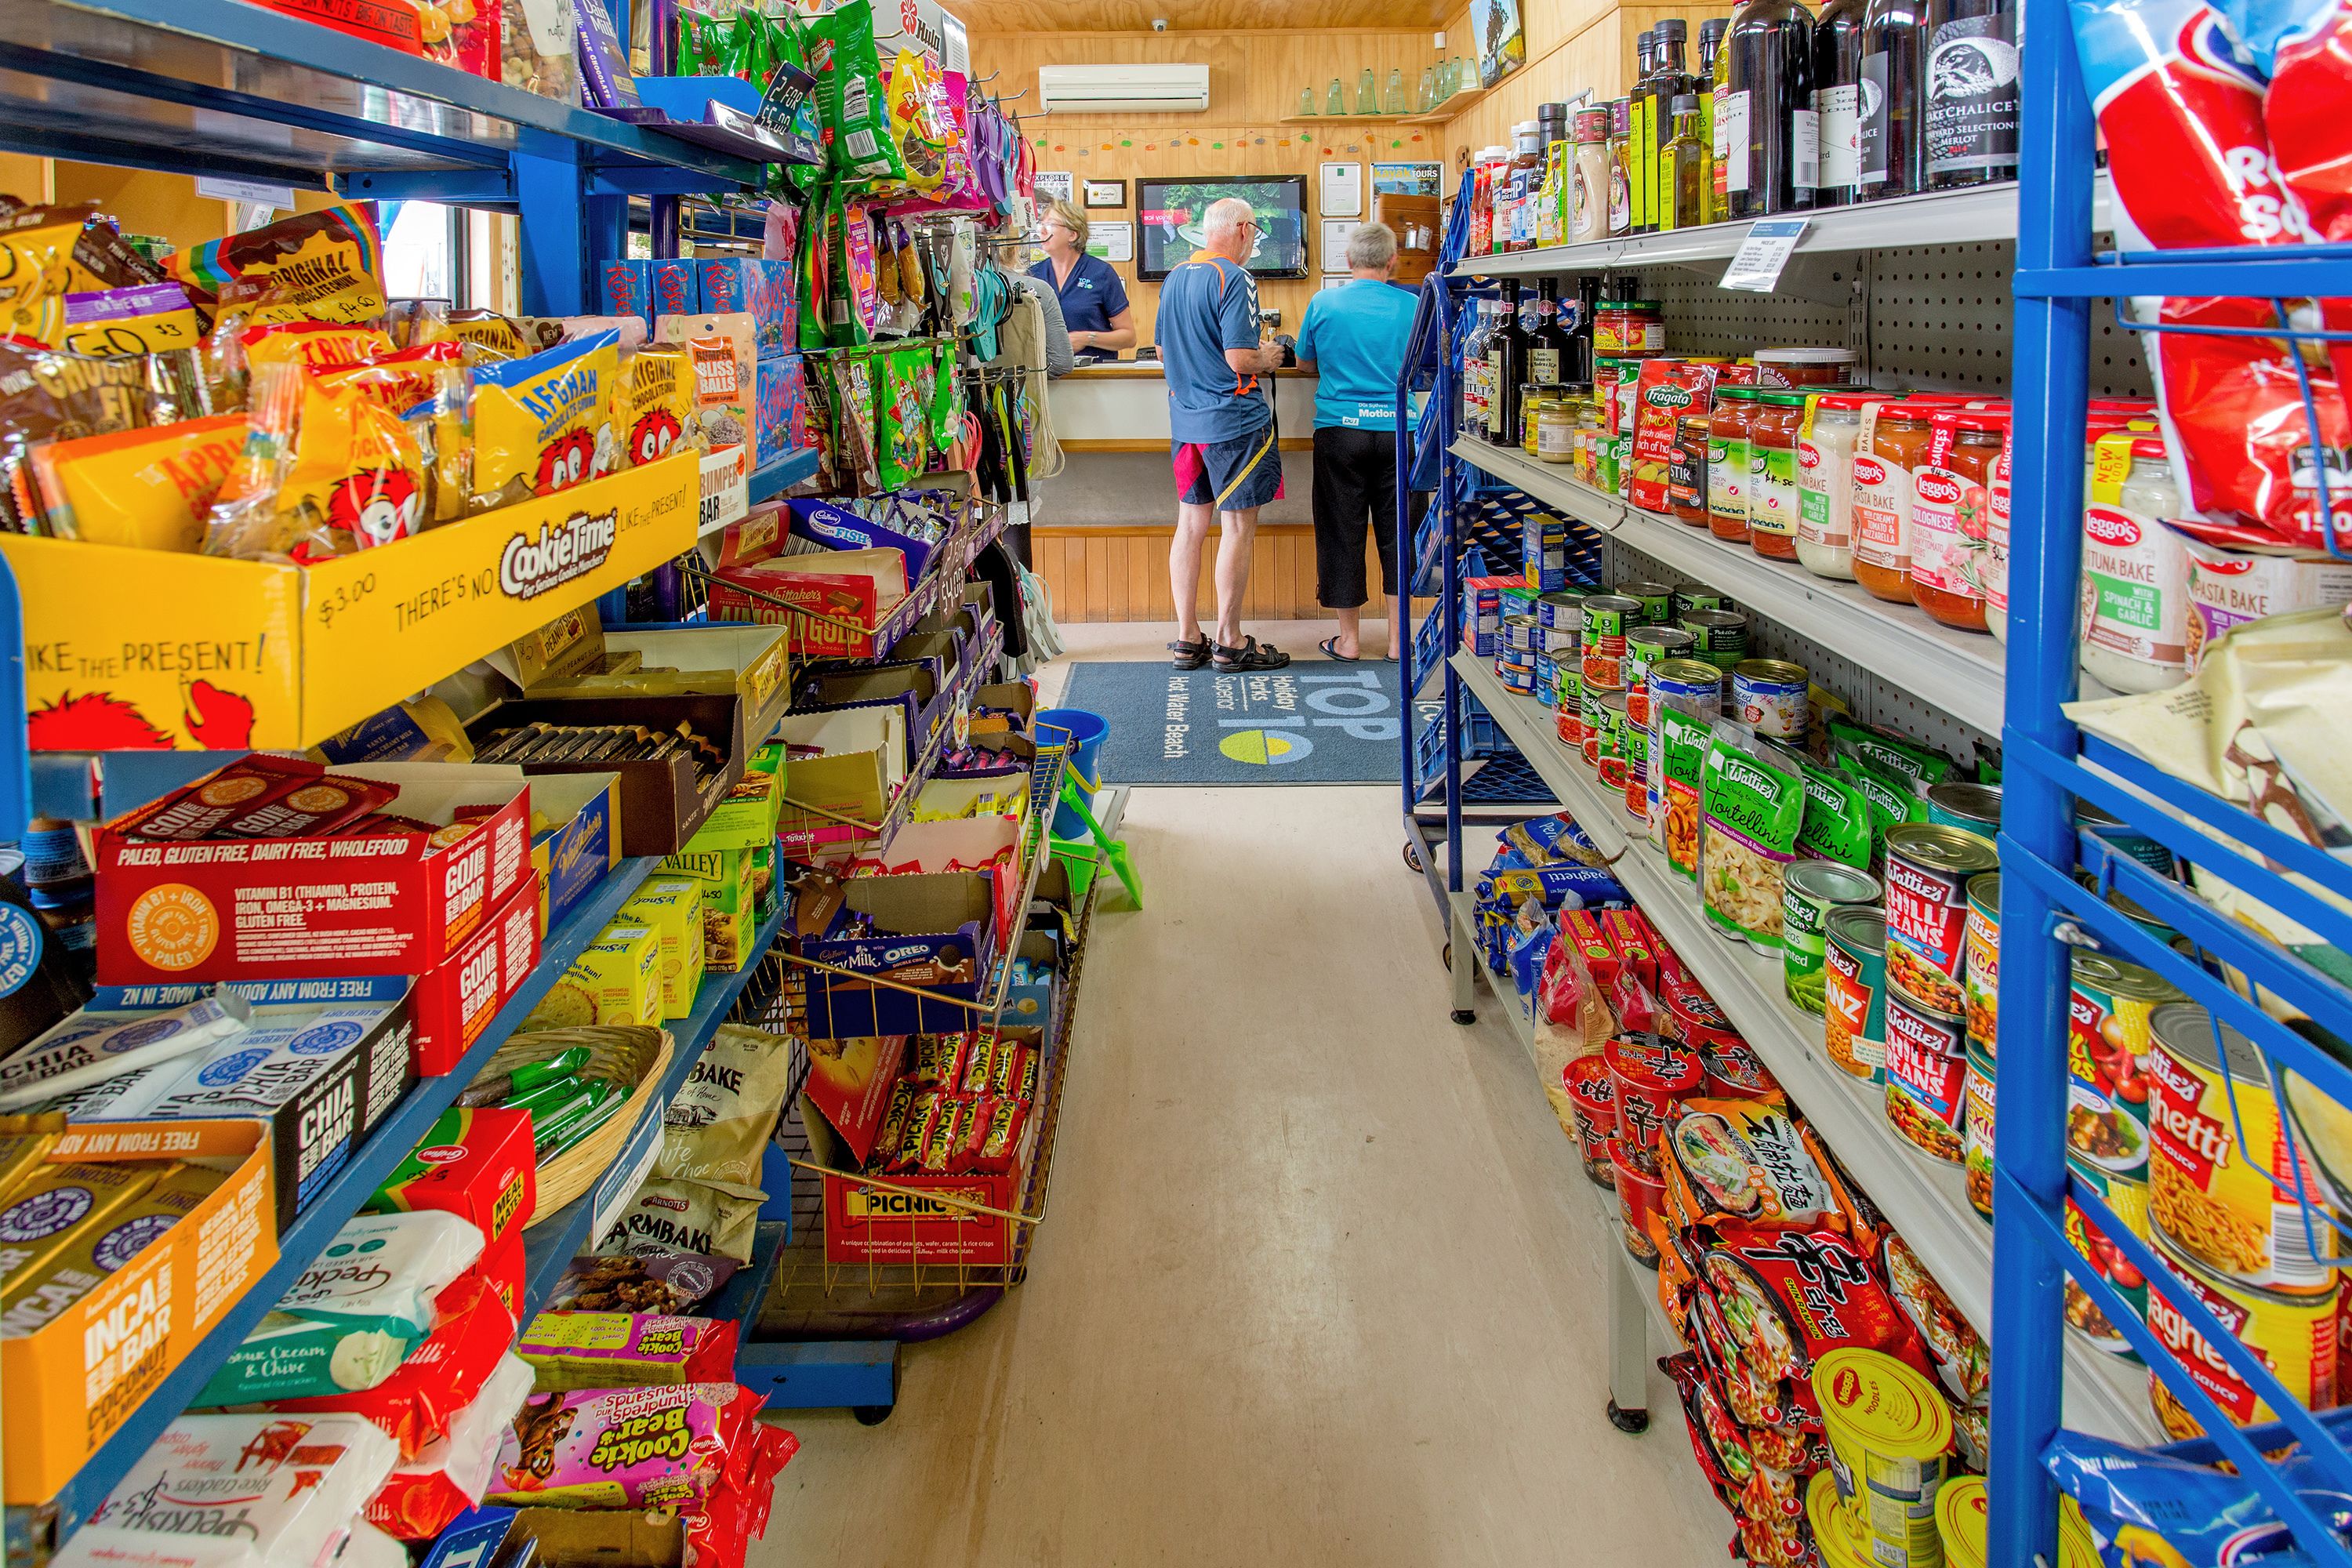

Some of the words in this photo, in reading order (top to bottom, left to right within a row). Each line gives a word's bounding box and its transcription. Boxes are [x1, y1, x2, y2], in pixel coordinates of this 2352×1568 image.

[916, 18, 941, 52] Hula
[580, 31, 593, 53] MILK
[590, 54, 612, 100] CHOCOLATE
[769, 75, 787, 103] 2
[780, 85, 804, 111] FOR
[1946, 100, 2011, 119] CHALICE
[1940, 134, 1977, 147] MERLOT
[1957, 121, 2014, 135] SELECTION
[1374, 167, 1411, 179] kayak
[1411, 169, 1438, 179] TOURS
[543, 328, 558, 343] NEW
[695, 348, 734, 362] BUMPER
[697, 360, 735, 378] BLISS
[520, 369, 599, 425] AFGHAN
[700, 376, 737, 394] BALLS
[1646, 385, 1691, 406] Fragata
[1359, 408, 1396, 418] Motion
[1573, 434, 1586, 448] OXO
[1655, 430, 1672, 441] olives
[1676, 422, 1685, 444] DELI
[1860, 417, 1872, 452] BAKES
[1595, 441, 1608, 456] OXO
[1931, 428, 1947, 467] SAUCES
[1670, 466, 1691, 481] STIR
[1853, 460, 1886, 486] Leggo's
[2096, 445, 2114, 484] NEW
[699, 467, 739, 499] BUMPER
[1635, 488, 1645, 499] 70g
[1809, 474, 1827, 493] BAKE
[1918, 475, 1961, 502] Leggo's
[699, 498, 720, 525] BAR
[1875, 494, 1895, 510] BAKE
[1808, 510, 1826, 524] GARLIC
[1867, 519, 1888, 533] TOMATO
[1872, 511, 1895, 524] CREAMY
[2085, 510, 2139, 543] Leggo's
[810, 521, 836, 535] CHOCOLATE
[835, 527, 869, 545] FISH
[1862, 528, 1896, 545] MOZZARELLA
[395, 573, 466, 633] THERE'S
[471, 568, 494, 601] NO
[500, 514, 617, 595] CookieTime
[620, 507, 640, 532] LIKE
[639, 512, 651, 528] THE
[652, 483, 688, 519] PRESENT!
[2090, 551, 2118, 574] TUNA
[2119, 558, 2156, 583] BAKE
[318, 573, 376, 629] $3.00
[2104, 590, 2140, 612] SPINACH
[2143, 601, 2154, 615] &
[2132, 586, 2154, 600] WITH
[2195, 577, 2225, 605] PASTA
[2230, 587, 2269, 615] BAKE
[2118, 607, 2154, 627] GARLIC
[78, 655, 120, 679] THE
[122, 633, 265, 674] PRESENT!
[1167, 676, 1185, 695] Hot
[1214, 676, 1237, 712] Superior
[1249, 675, 1272, 702] Parks
[1271, 675, 1298, 711] Holiday
[1167, 695, 1185, 722] Water
[1301, 670, 1402, 742] TOP
[1163, 723, 1190, 759] Beach
[1728, 762, 1777, 802] Wattie's
[1704, 781, 1783, 848] Tortellini
[1706, 815, 1723, 831] Creamy
[1722, 824, 1748, 846] Mushroom
[1752, 840, 1768, 858] Bacon
[117, 848, 163, 867] PALEO,
[164, 846, 212, 865] GLUTEN
[212, 844, 250, 864] FREE,
[250, 843, 290, 862] DAIRY
[290, 841, 328, 860] FREE,
[329, 838, 409, 858] WHOLEFOOD
[665, 851, 719, 878] VALLEY
[445, 851, 479, 899] GOJI
[1886, 860, 1948, 903] Wattie's
[234, 887, 278, 902] VITAMIN
[279, 887, 293, 899] B1
[294, 884, 348, 900] (THIAMIN),
[350, 881, 400, 897] PROTEIN,
[461, 875, 485, 913] BAR
[235, 902, 265, 915] IRON,
[266, 900, 314, 913] OMEGA-3
[325, 896, 394, 911] MAGNESIUM.
[1886, 883, 1948, 931] CHILLI
[235, 914, 275, 929] GLUTEN
[276, 913, 307, 927] FREE.
[1886, 909, 1945, 949] BEANS
[848, 954, 880, 969] Milk
[884, 944, 930, 963] OREO
[892, 960, 911, 968] DOUBLE
[460, 943, 492, 1000] GOJI
[122, 988, 140, 1005] NZ
[142, 987, 156, 1004] IN
[269, 983, 298, 1001] ANY
[299, 982, 337, 1000] FROM
[339, 981, 372, 998] FREE
[477, 969, 498, 1007] BAR
[1886, 1007, 1947, 1051] Wattie's
[1886, 1057, 1945, 1098] BEANS
[299, 1074, 354, 1150] CHIA
[82, 1132, 113, 1153] ANY
[115, 1131, 159, 1152] FROM
[161, 1131, 201, 1151] FREE
[321, 1107, 354, 1162] BAR
[2162, 1140, 2198, 1173] sauce
[495, 1172, 524, 1214] MEAL
[866, 1193, 948, 1214] PICNIC
[493, 1193, 524, 1242] MATES
[978, 1240, 994, 1248] crisps
[1784, 1276, 1802, 1308] SHIN
[1796, 1300, 1822, 1341] RAMYUN
[84, 1277, 157, 1373] INCA
[648, 1330, 682, 1342] Bear
[121, 1304, 172, 1375] BAR
[637, 1341, 682, 1354] Cookie
[267, 1345, 327, 1363] Cream
[245, 1361, 256, 1377] &
[260, 1359, 307, 1377] Chive
[1838, 1371, 1860, 1406] Maggi
[1864, 1380, 1879, 1416] NOODLES
[2193, 1369, 2240, 1405] sauce
[610, 1392, 690, 1423] hundreds
[615, 1406, 686, 1443] Bear
[591, 1430, 691, 1472] Cookie
